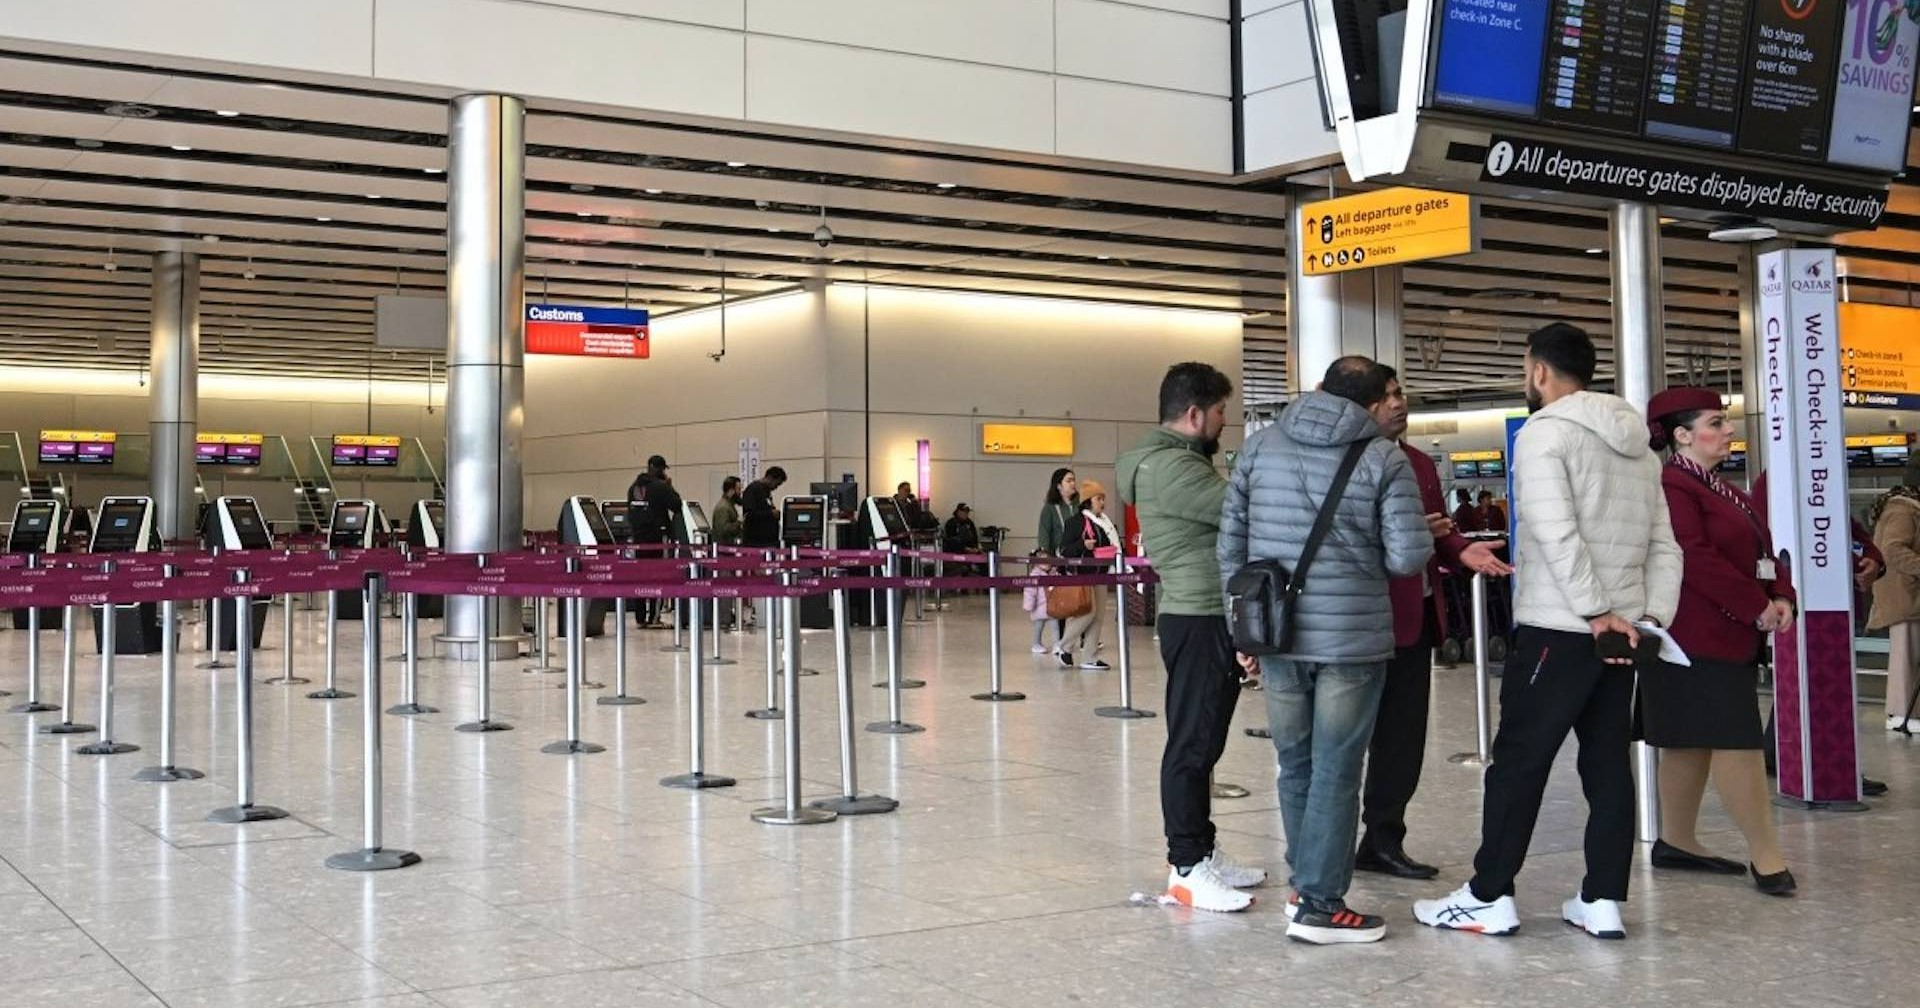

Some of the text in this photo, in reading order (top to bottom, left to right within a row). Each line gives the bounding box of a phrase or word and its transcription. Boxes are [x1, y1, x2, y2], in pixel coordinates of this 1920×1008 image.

[1450, 6, 1488, 24] check-in
[1489, 13, 1513, 28] Zone
[1760, 25, 1805, 45] No sharps
[1758, 42, 1814, 62] with a blade
[1756, 60, 1798, 75] over 6cm
[1840, 63, 1911, 95] SAVINGS
[1514, 146, 1886, 224] All departures gates displayed after security
[1335, 198, 1449, 225] All departure gates
[1335, 228, 1351, 238] Left
[1353, 222, 1392, 234] baggage
[1367, 245, 1396, 257] Toilets
[1791, 280, 1832, 291] QATAR
[529, 306, 584, 322] Customs
[1805, 314, 1825, 360] Web
[1767, 317, 1785, 441] Check-in
[1884, 381, 1908, 390] parking
[1865, 393, 1898, 405] Assistance
[1807, 368, 1828, 459] Check-in
[1808, 468, 1829, 507] Bag
[1810, 516, 1831, 568] Drop
[1, 585, 25, 594] QATAR
[224, 585, 250, 595] QATAR
[553, 587, 575, 595] QATAR
[635, 588, 656, 596] QATAR
[69, 594, 97, 602] QATAR
